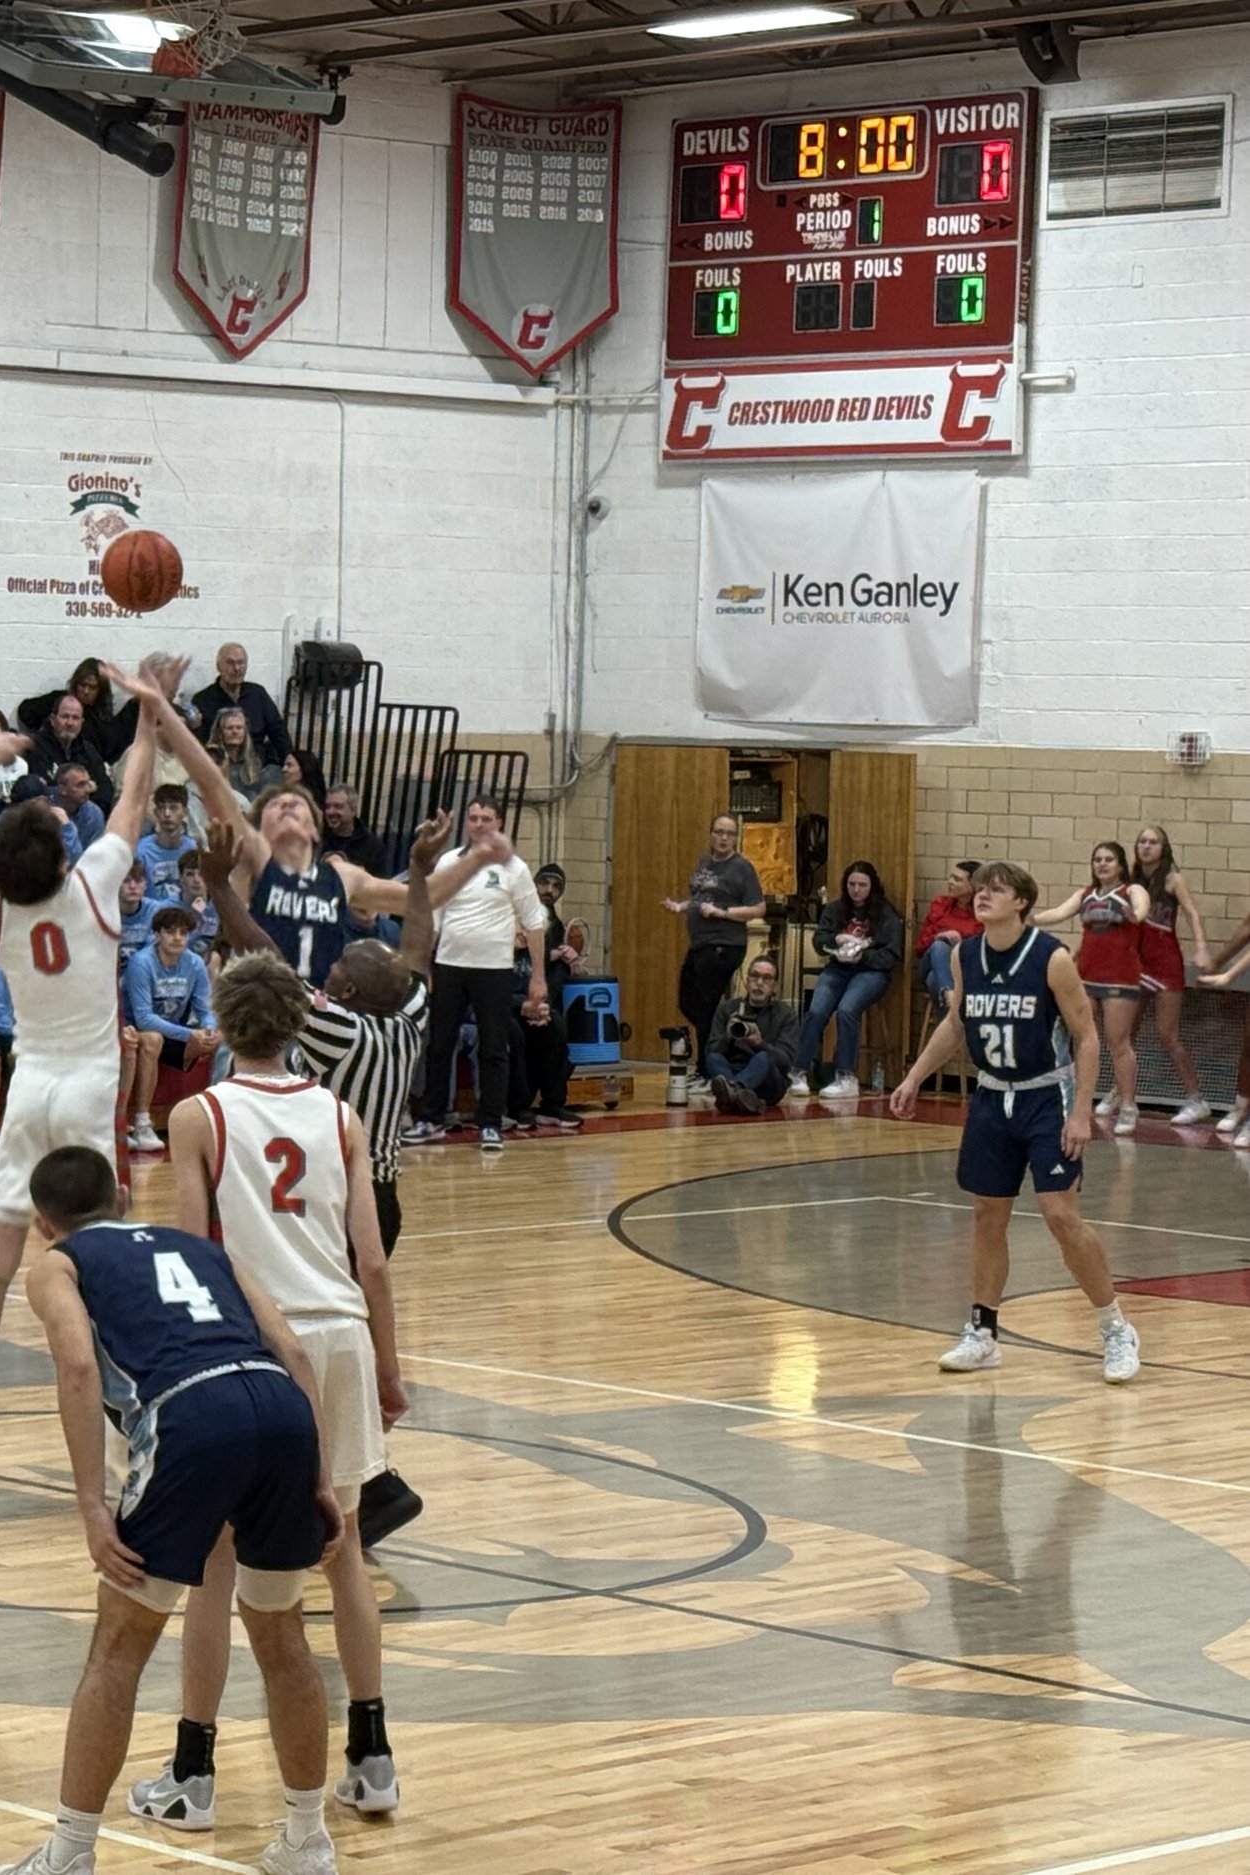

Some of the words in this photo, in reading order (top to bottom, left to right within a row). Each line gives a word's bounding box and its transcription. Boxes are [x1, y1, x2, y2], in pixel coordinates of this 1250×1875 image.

[466, 108, 539, 135] SCARLET
[548, 116, 610, 137] GUARD
[935, 102, 1020, 135] VISITOR
[224, 123, 279, 145] LEAGUE
[468, 133, 517, 149] STATE
[521, 138, 607, 154] QUALIFIED
[683, 126, 750, 156] DEVILS
[798, 114, 915, 179] 8:00
[504, 152, 533, 168] 2001
[980, 142, 1011, 201] 0
[501, 186, 533, 201] 2009
[502, 170, 534, 185] 2005
[541, 172, 571, 187] 2006
[577, 174, 606, 188] 2007
[719, 164, 746, 221] 0
[810, 192, 840, 208] POSS
[796, 210, 852, 232] PERIOD
[873, 200, 881, 242] 1
[926, 214, 981, 238] BONUS
[704, 230, 753, 251] BONUS
[695, 267, 741, 289] FOULS
[785, 261, 842, 283] PLAYER
[854, 257, 903, 279] FOULS
[936, 252, 987, 275] FOULS
[716, 291, 738, 334] 0
[961, 277, 983, 322] 0
[665, 372, 727, 454] C
[727, 398, 834, 427] CRESTWOOD
[836, 397, 872, 422] RED
[872, 394, 935, 421] DEVILS
[940, 360, 1007, 446] C
[68, 471, 142, 498] Gionino's
[7, 577, 48, 594] Official
[50, 579, 77, 596] Pizza
[79, 581, 91, 596] of
[783, 573, 844, 608] Ken
[850, 572, 960, 617] Ganley
[782, 611, 857, 625] CHEVROLET
[858, 611, 911, 625] AURORA
[265, 885, 341, 924] ROVERS
[30, 921, 71, 975] 0
[296, 926, 314, 979] 1
[965, 994, 1037, 1019] ROVERS
[979, 1024, 1017, 1069] 21
[263, 1136, 307, 1217] 2
[153, 1251, 223, 1323] 4
